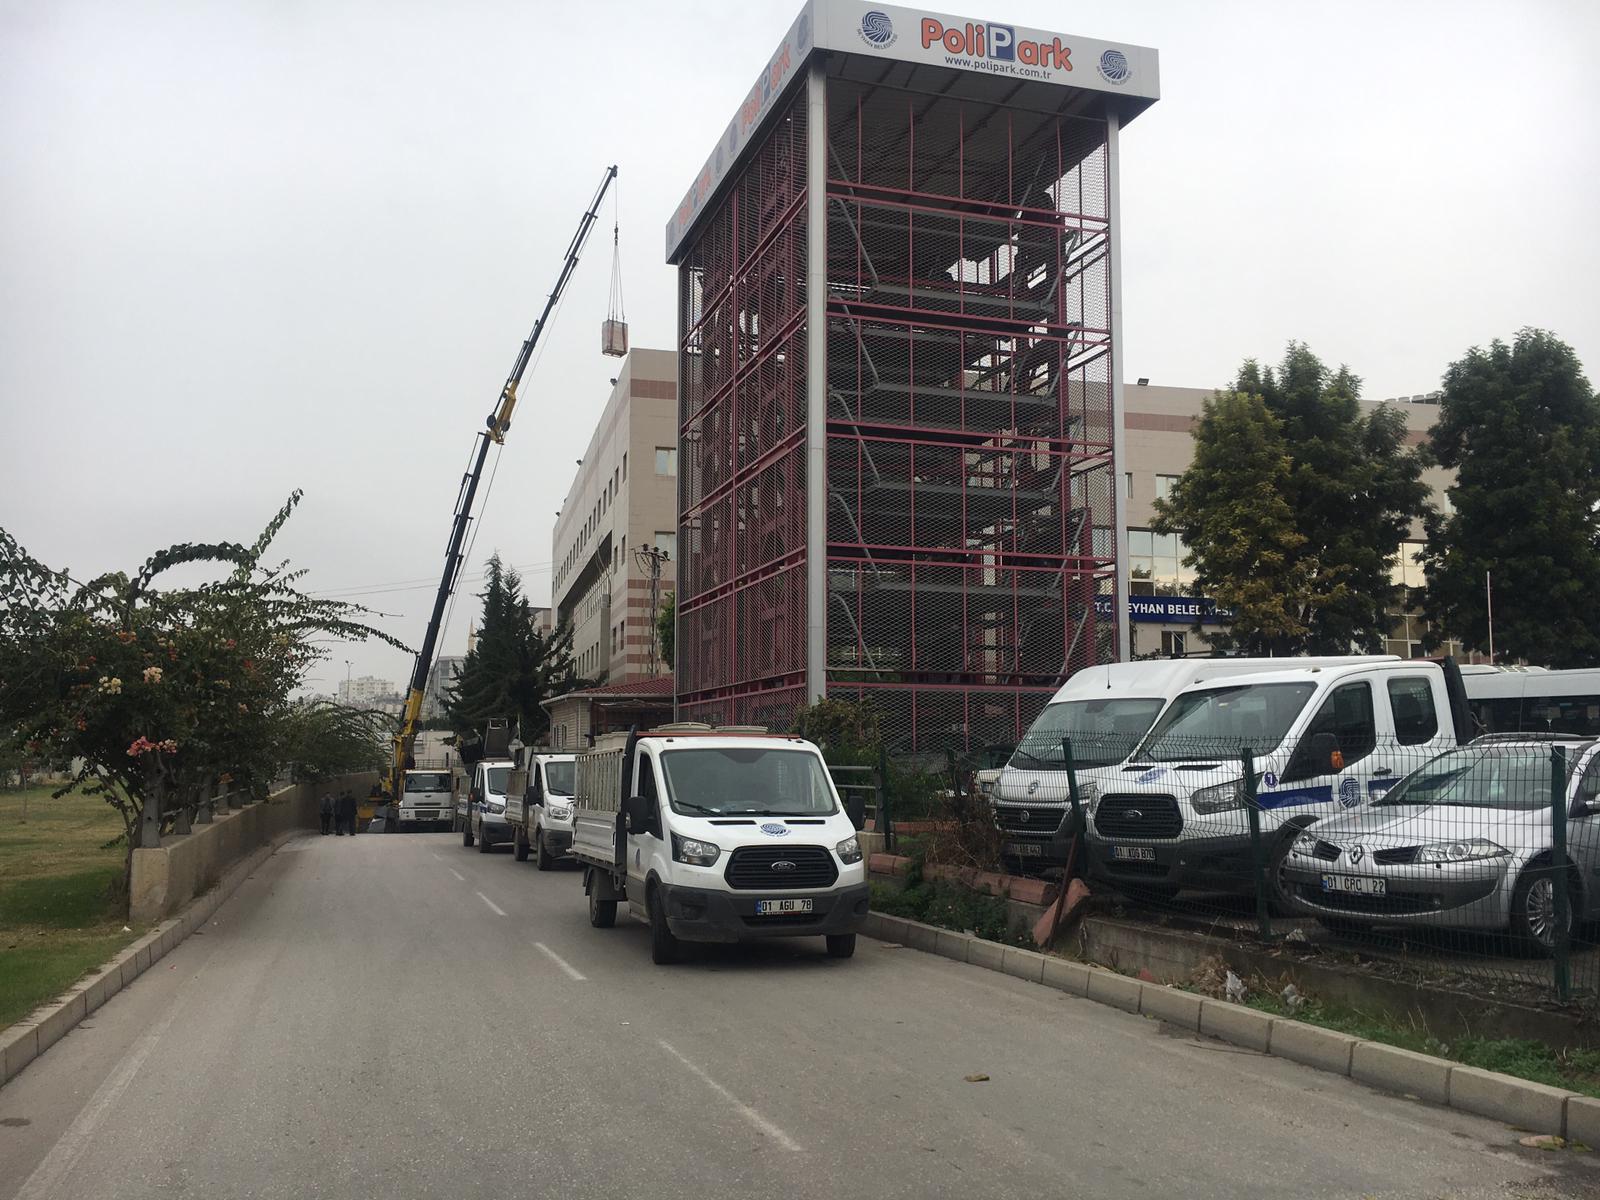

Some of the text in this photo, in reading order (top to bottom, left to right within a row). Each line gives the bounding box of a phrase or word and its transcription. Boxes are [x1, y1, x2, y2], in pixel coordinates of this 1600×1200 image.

[944, 55, 1052, 79] www.polipark.com.tr
[1128, 602, 1164, 614] EYHAN
[1373, 880, 1385, 893] 22
[762, 899, 812, 912] 01 AGU 78
